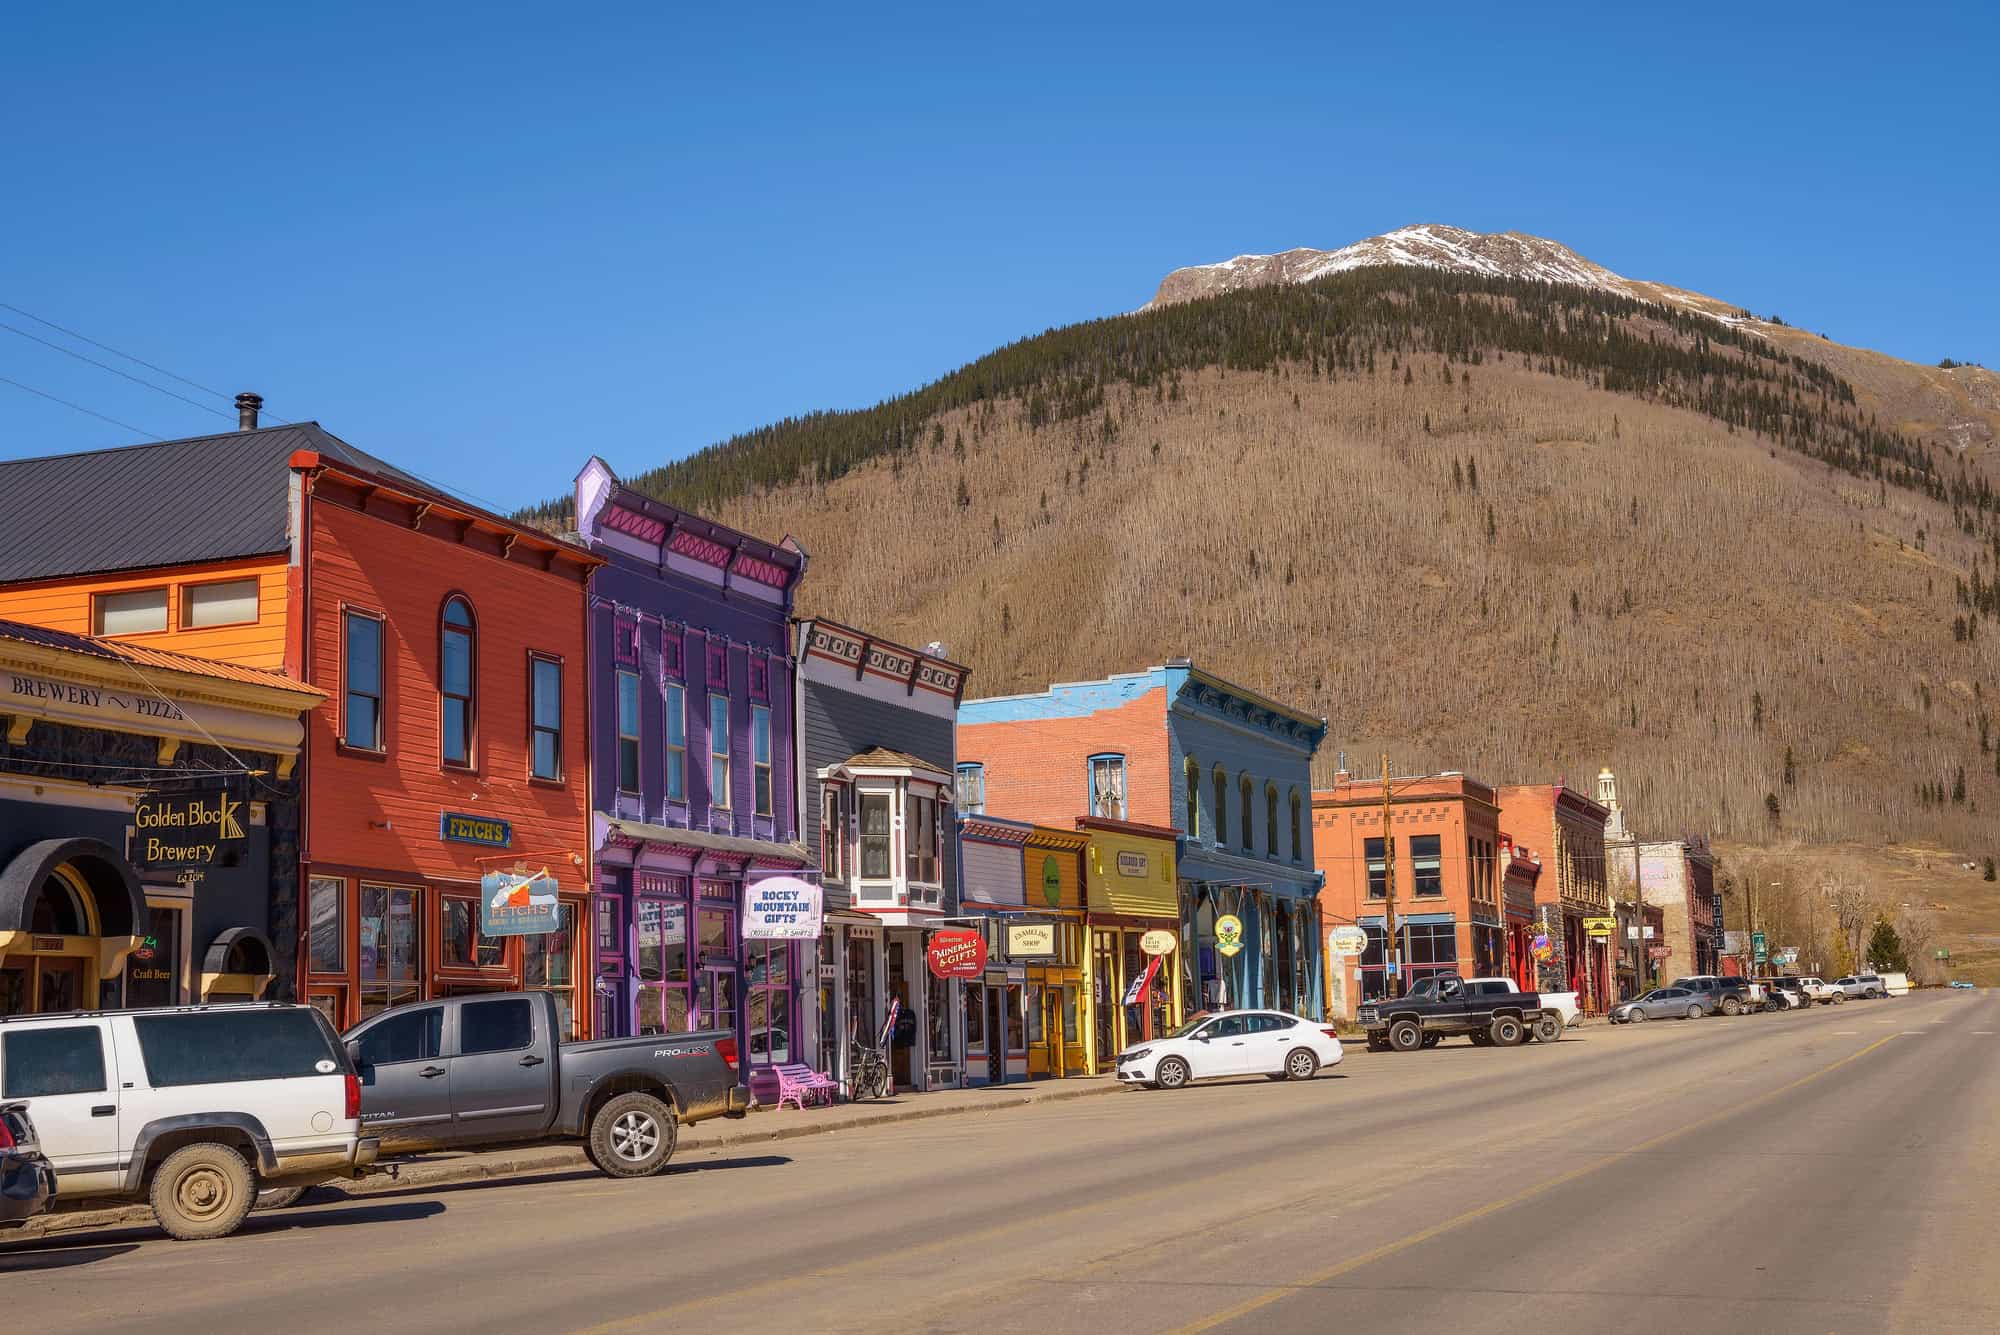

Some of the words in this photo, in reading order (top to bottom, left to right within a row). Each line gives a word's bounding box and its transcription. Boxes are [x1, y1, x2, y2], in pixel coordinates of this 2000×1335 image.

[11, 676, 102, 707] BREWERY
[136, 698, 185, 721] PIZZA
[135, 803, 185, 829] Golden
[450, 818, 504, 842] FETCH'S
[147, 838, 216, 863] Brewery
[762, 890, 799, 901] ROCKY
[753, 902, 811, 912] MOUNTAIN
[764, 914, 797, 924] GIFTS
[1712, 895, 1724, 948] HOTEL
[1014, 929, 1049, 940] ENAMELING
[931, 938, 977, 960] MINERALS
[133, 968, 152, 979] Craft
[361, 1111, 395, 1120] TITAN
